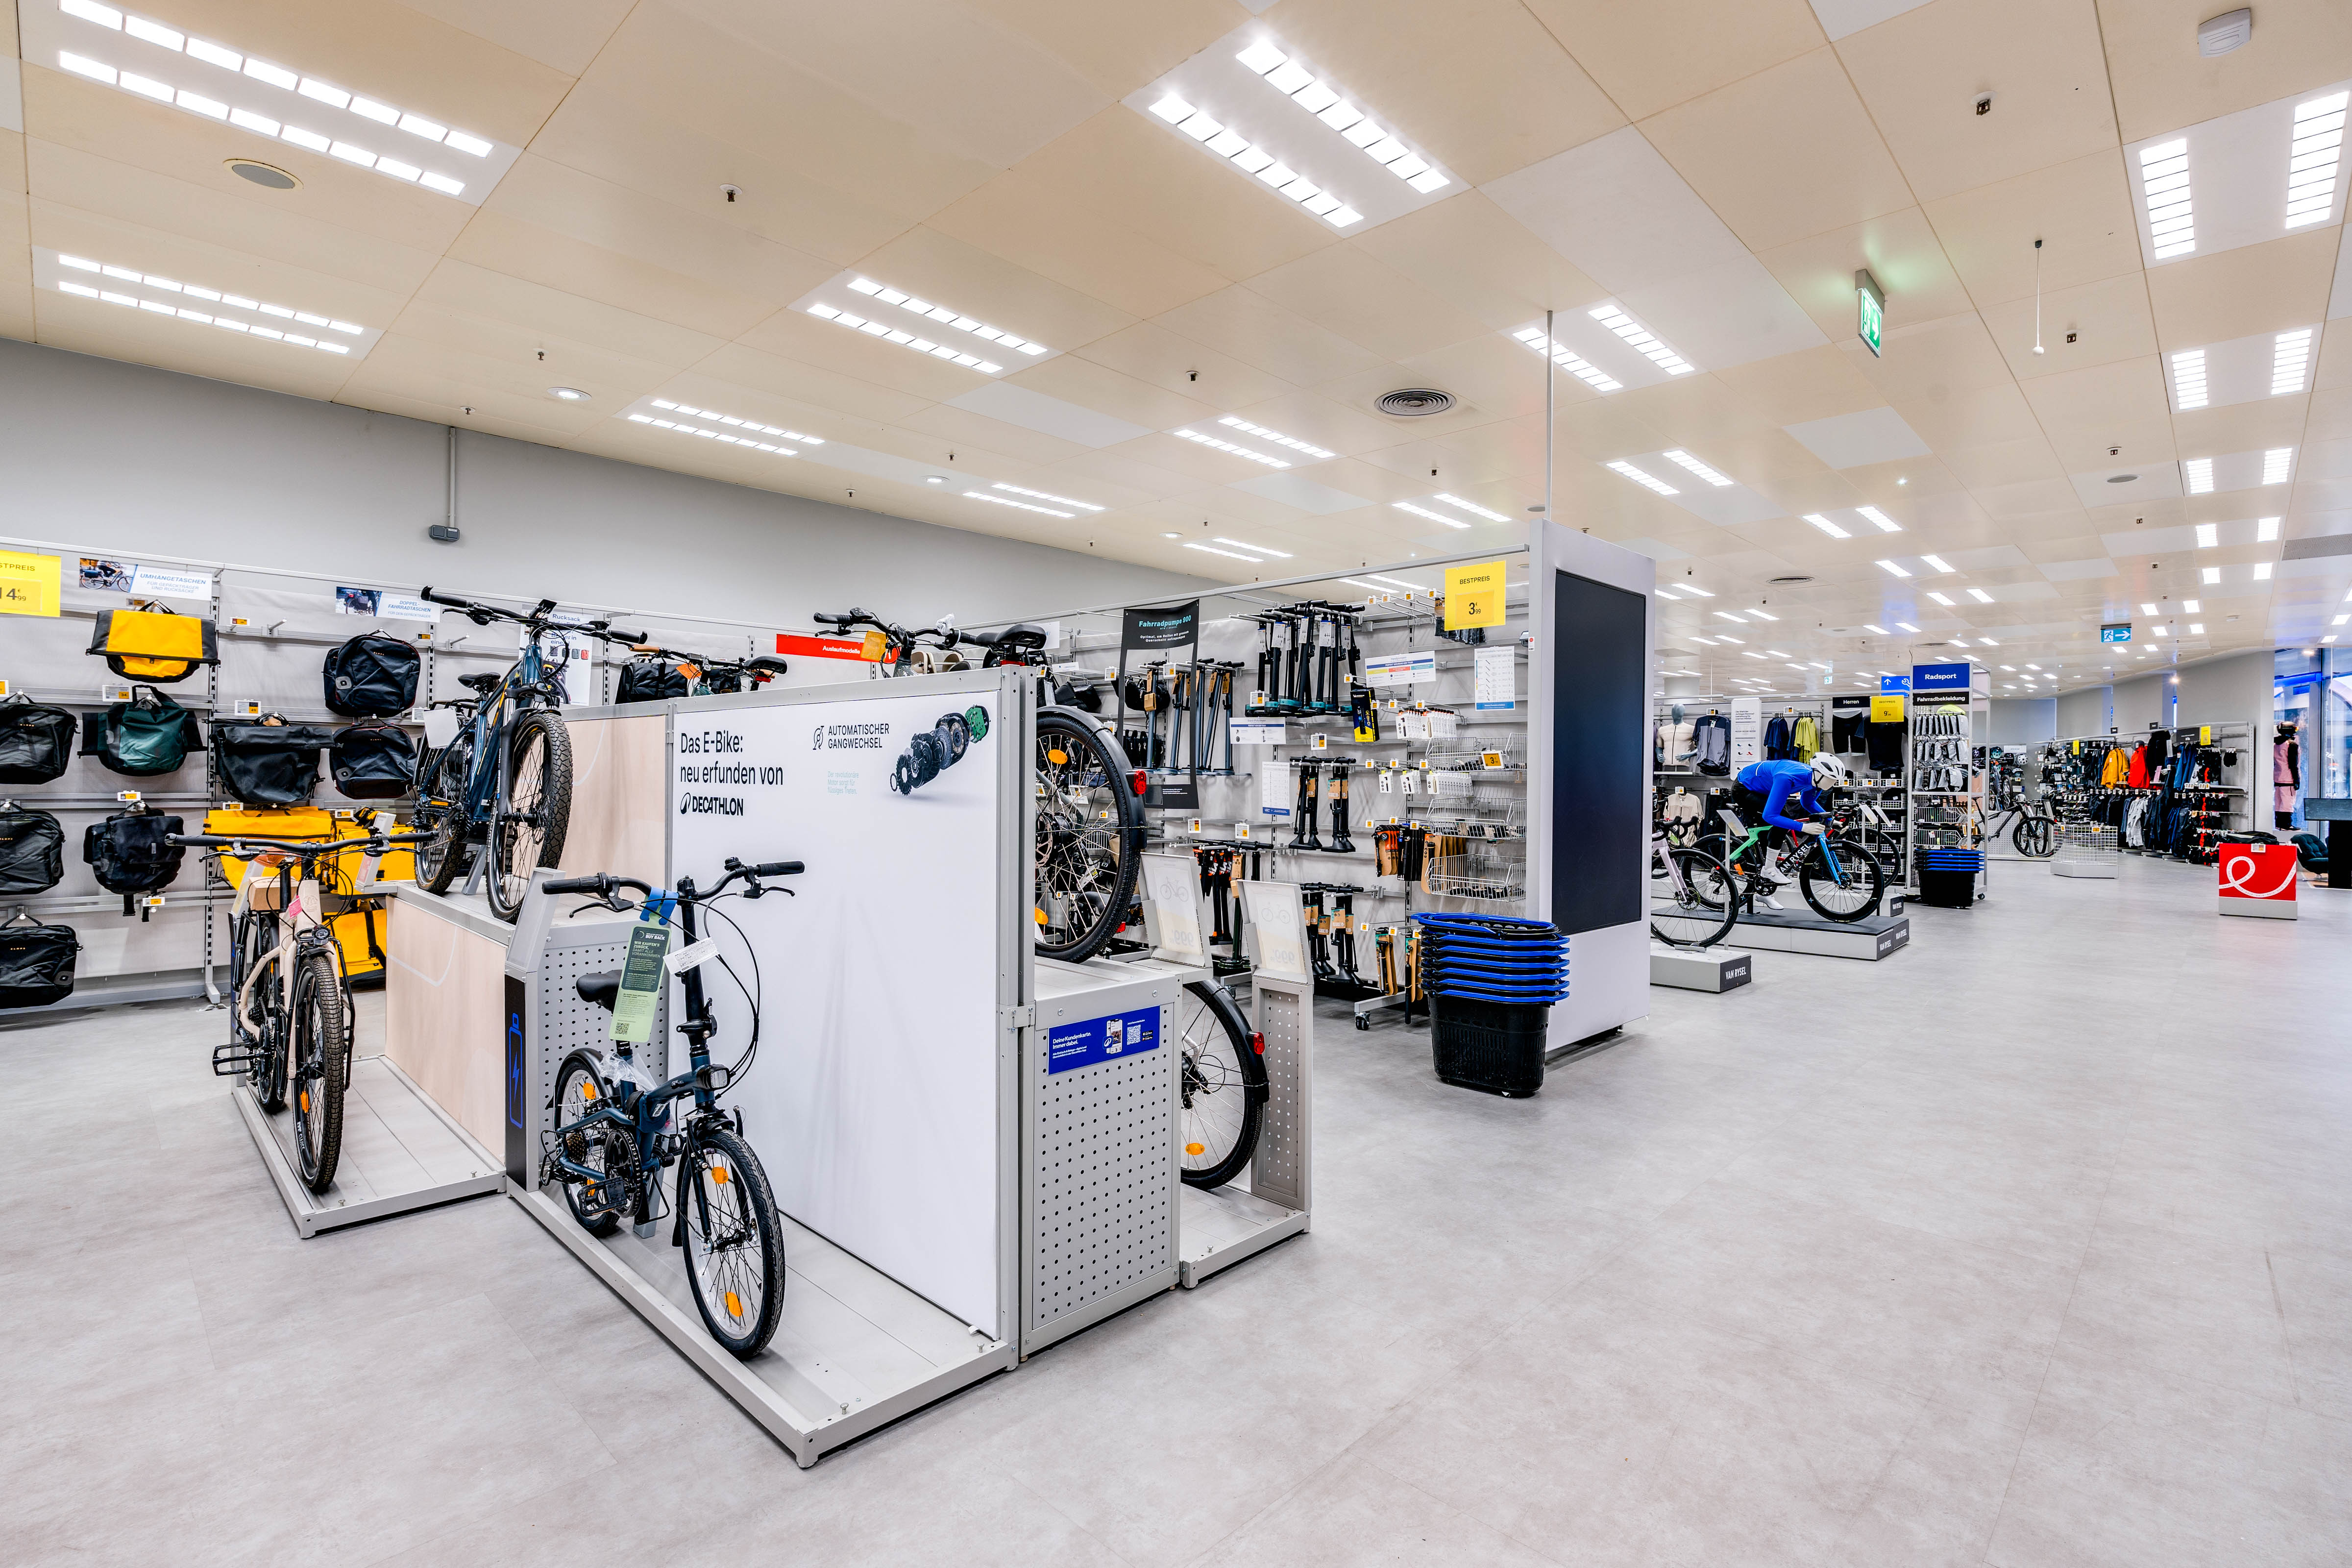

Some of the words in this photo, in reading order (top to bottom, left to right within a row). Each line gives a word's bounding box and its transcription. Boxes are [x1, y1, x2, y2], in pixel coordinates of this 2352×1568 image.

[1460, 576, 1490, 584] BESTPREIS
[552, 613, 581, 622] Rucksack
[822, 645, 860, 654] Auslaufmodelle
[828, 723, 889, 735] AUTOMATISCHER
[681, 733, 700, 753] Das
[704, 730, 743, 753] E-Bike:
[828, 737, 882, 749] GANGWECHSEL
[680, 766, 699, 783] neu
[703, 760, 756, 784] erfunden
[760, 766, 783, 785] von
[692, 796, 743, 816] DECATHLON
[1789, 844, 1812, 863] RYSEL
[1735, 966, 1746, 978] RYSEL
[1065, 1032, 1091, 1041] Kundenkarte.
